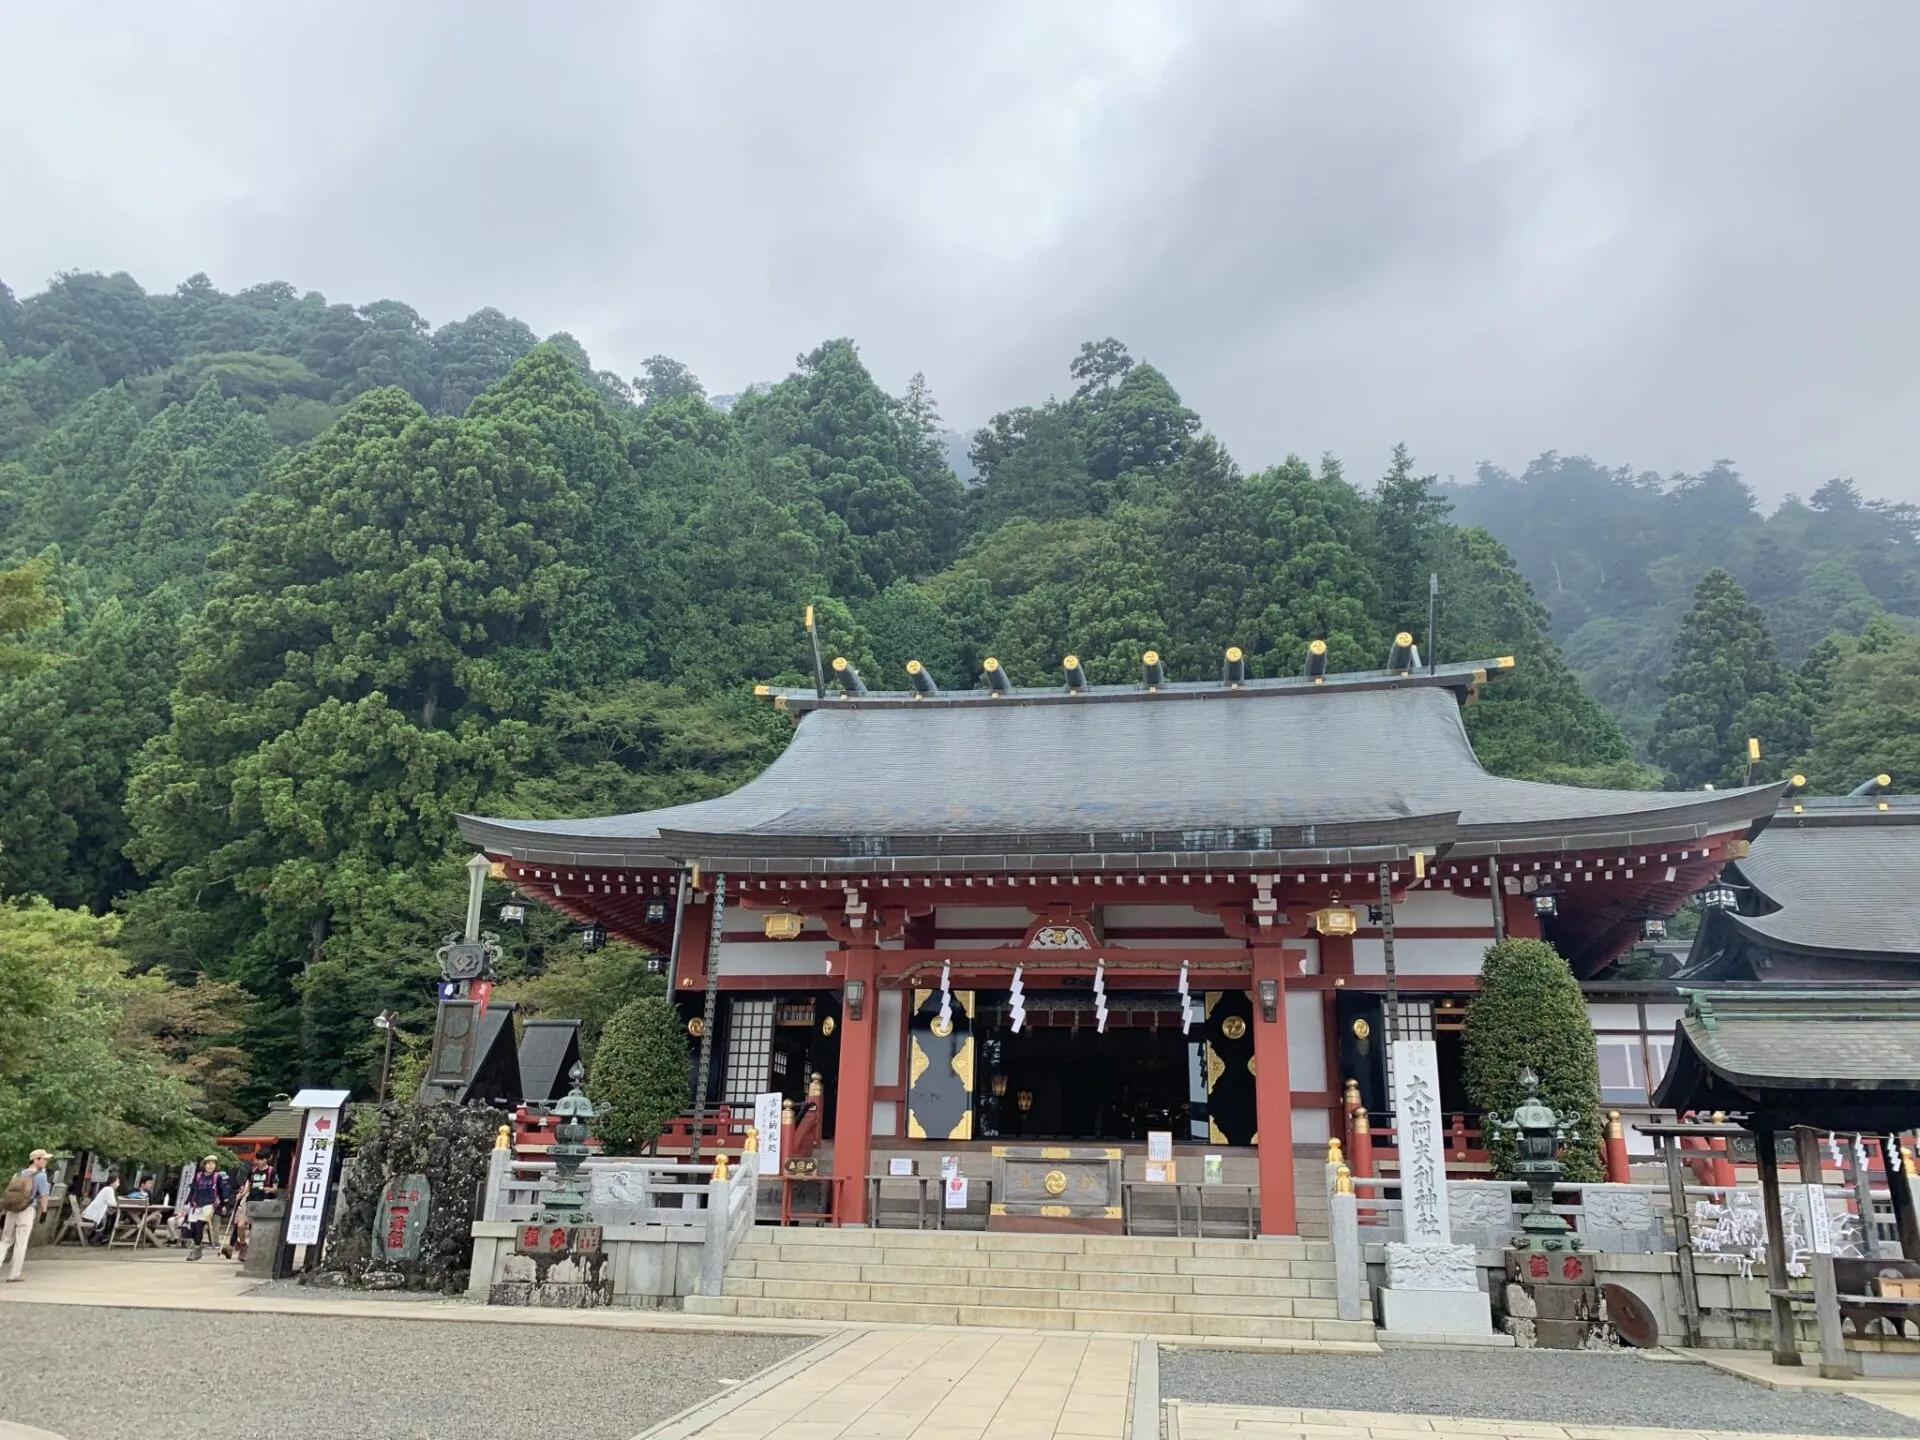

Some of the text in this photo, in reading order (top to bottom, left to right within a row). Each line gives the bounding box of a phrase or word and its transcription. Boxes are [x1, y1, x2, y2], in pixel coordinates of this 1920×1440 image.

[300, 1137, 329, 1210] 頂上登山口
[1403, 1074, 1441, 1236] 大山阿夫利神社
